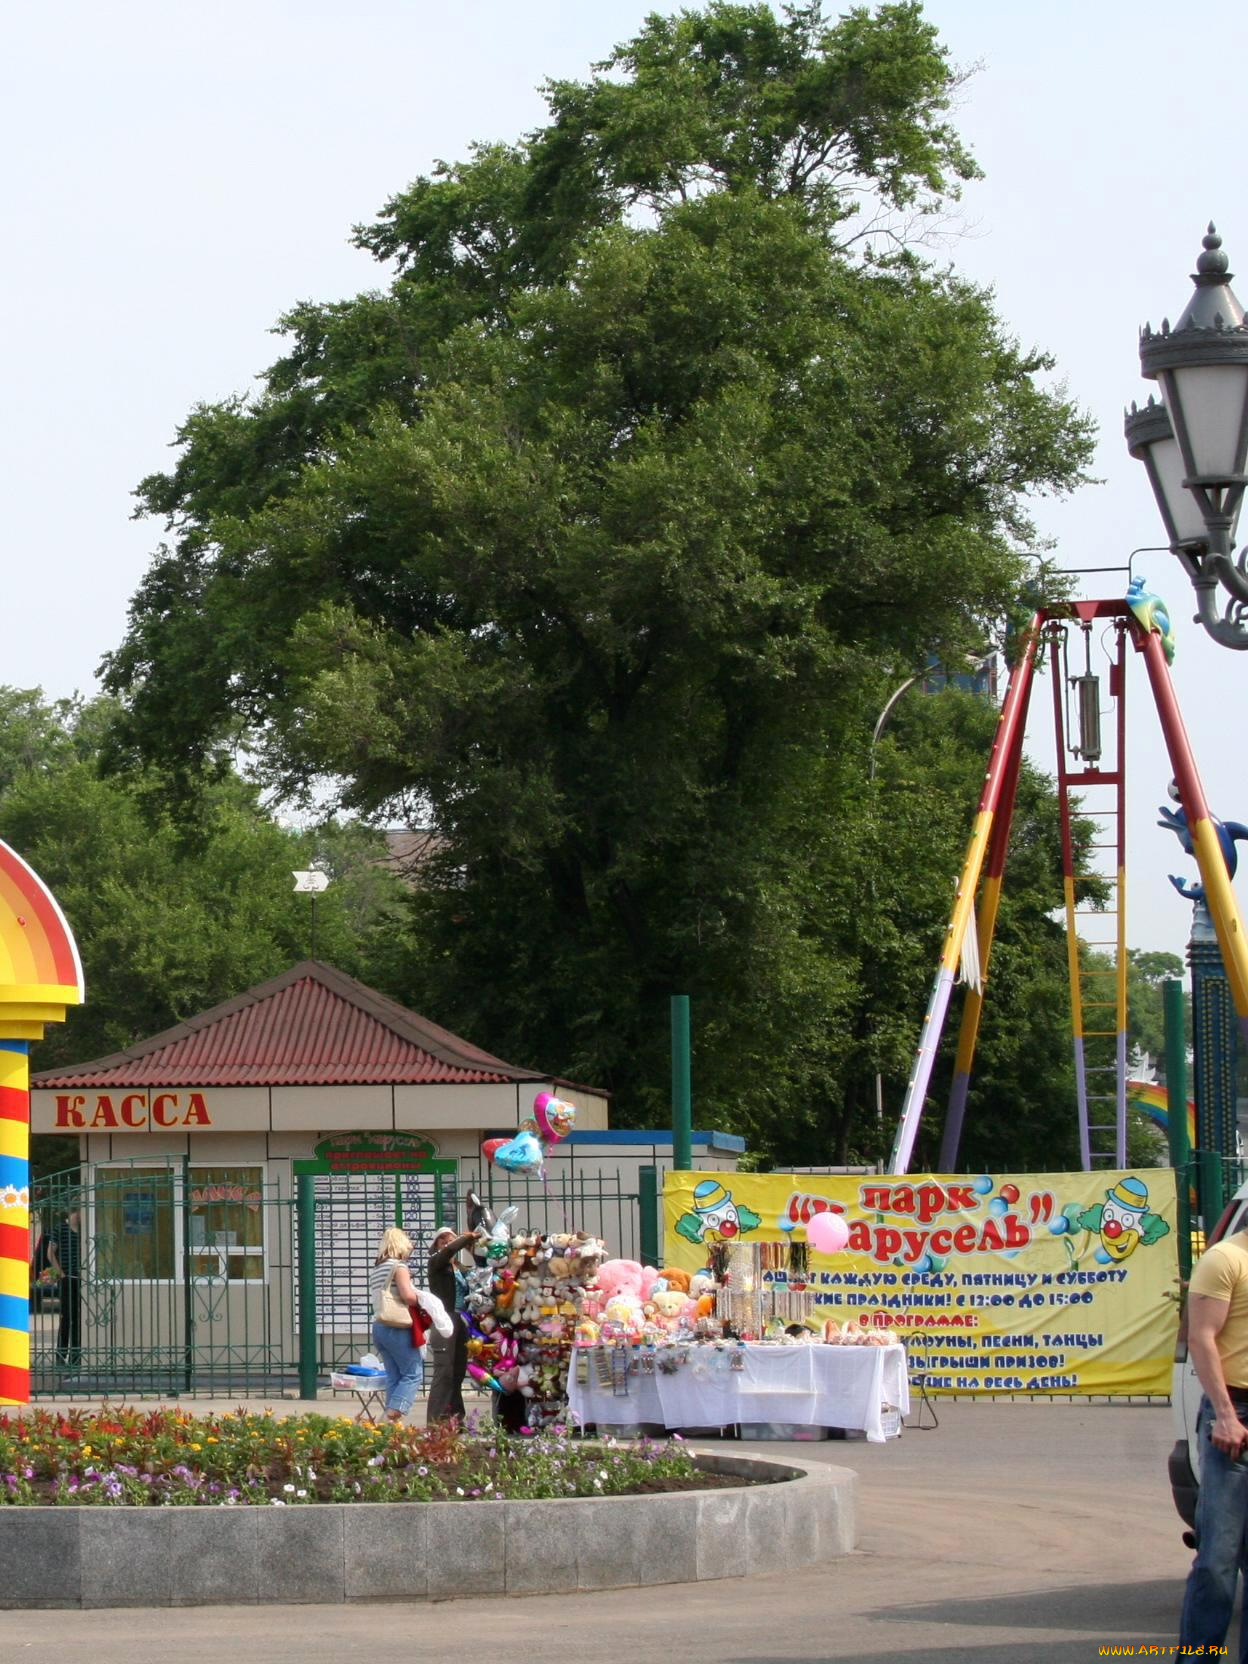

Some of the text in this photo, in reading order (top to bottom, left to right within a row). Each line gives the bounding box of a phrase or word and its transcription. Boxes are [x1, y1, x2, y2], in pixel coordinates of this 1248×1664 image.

[55, 1093, 211, 1128] КАССА
[862, 1182, 978, 1223] парк
[820, 1272, 897, 1286] КАЖДУЮ
[901, 1272, 957, 1288] СРЕДУ,
[961, 1272, 1038, 1288] ПЯТНИЦУ
[1042, 1273, 1053, 1286] И
[1056, 1269, 1128, 1285] СУББОТУ
[847, 1293, 952, 1308] ПРАЗДНИКИ!
[969, 1293, 1015, 1307] 12:00
[1018, 1293, 1045, 1308] ДО
[1049, 1291, 1094, 1306] 15:00
[858, 1314, 979, 1327] В ПРОГРАММЕ:
[981, 1335, 1039, 1349] ПЕСНИ,
[1042, 1334, 1103, 1349] ТАНЦЫ
[907, 1354, 1065, 1369] ЗЫГРЫШИ ПРИЗОВ!
[956, 1377, 979, 1388] НА
[983, 1377, 1023, 1388] ВЕСЬ
[1026, 1374, 1077, 1389] ДЕНЬ!
